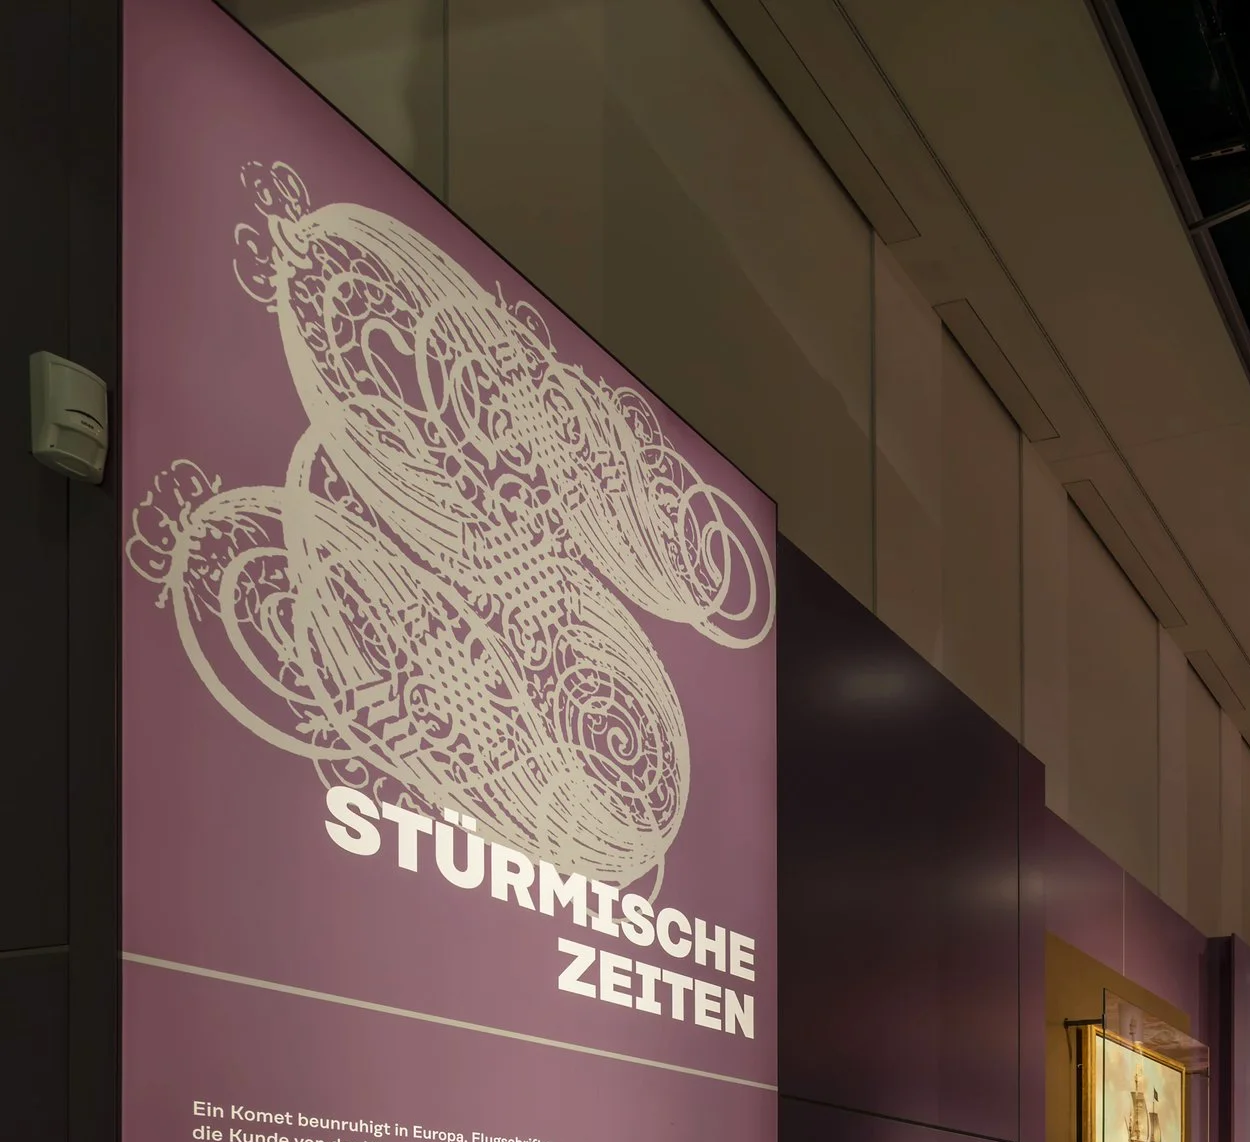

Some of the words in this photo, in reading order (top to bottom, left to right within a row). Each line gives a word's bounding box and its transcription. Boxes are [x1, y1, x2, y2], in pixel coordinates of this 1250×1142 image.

[325, 786, 755, 982] STÜRMISCHE
[558, 937, 755, 1039] ZEITEN
[193, 1125, 223, 1141] die
[194, 1101, 224, 1118] Ein
[231, 1105, 293, 1125] Komet
[298, 1112, 391, 1138] beunruhigt
[395, 1123, 408, 1137] in
